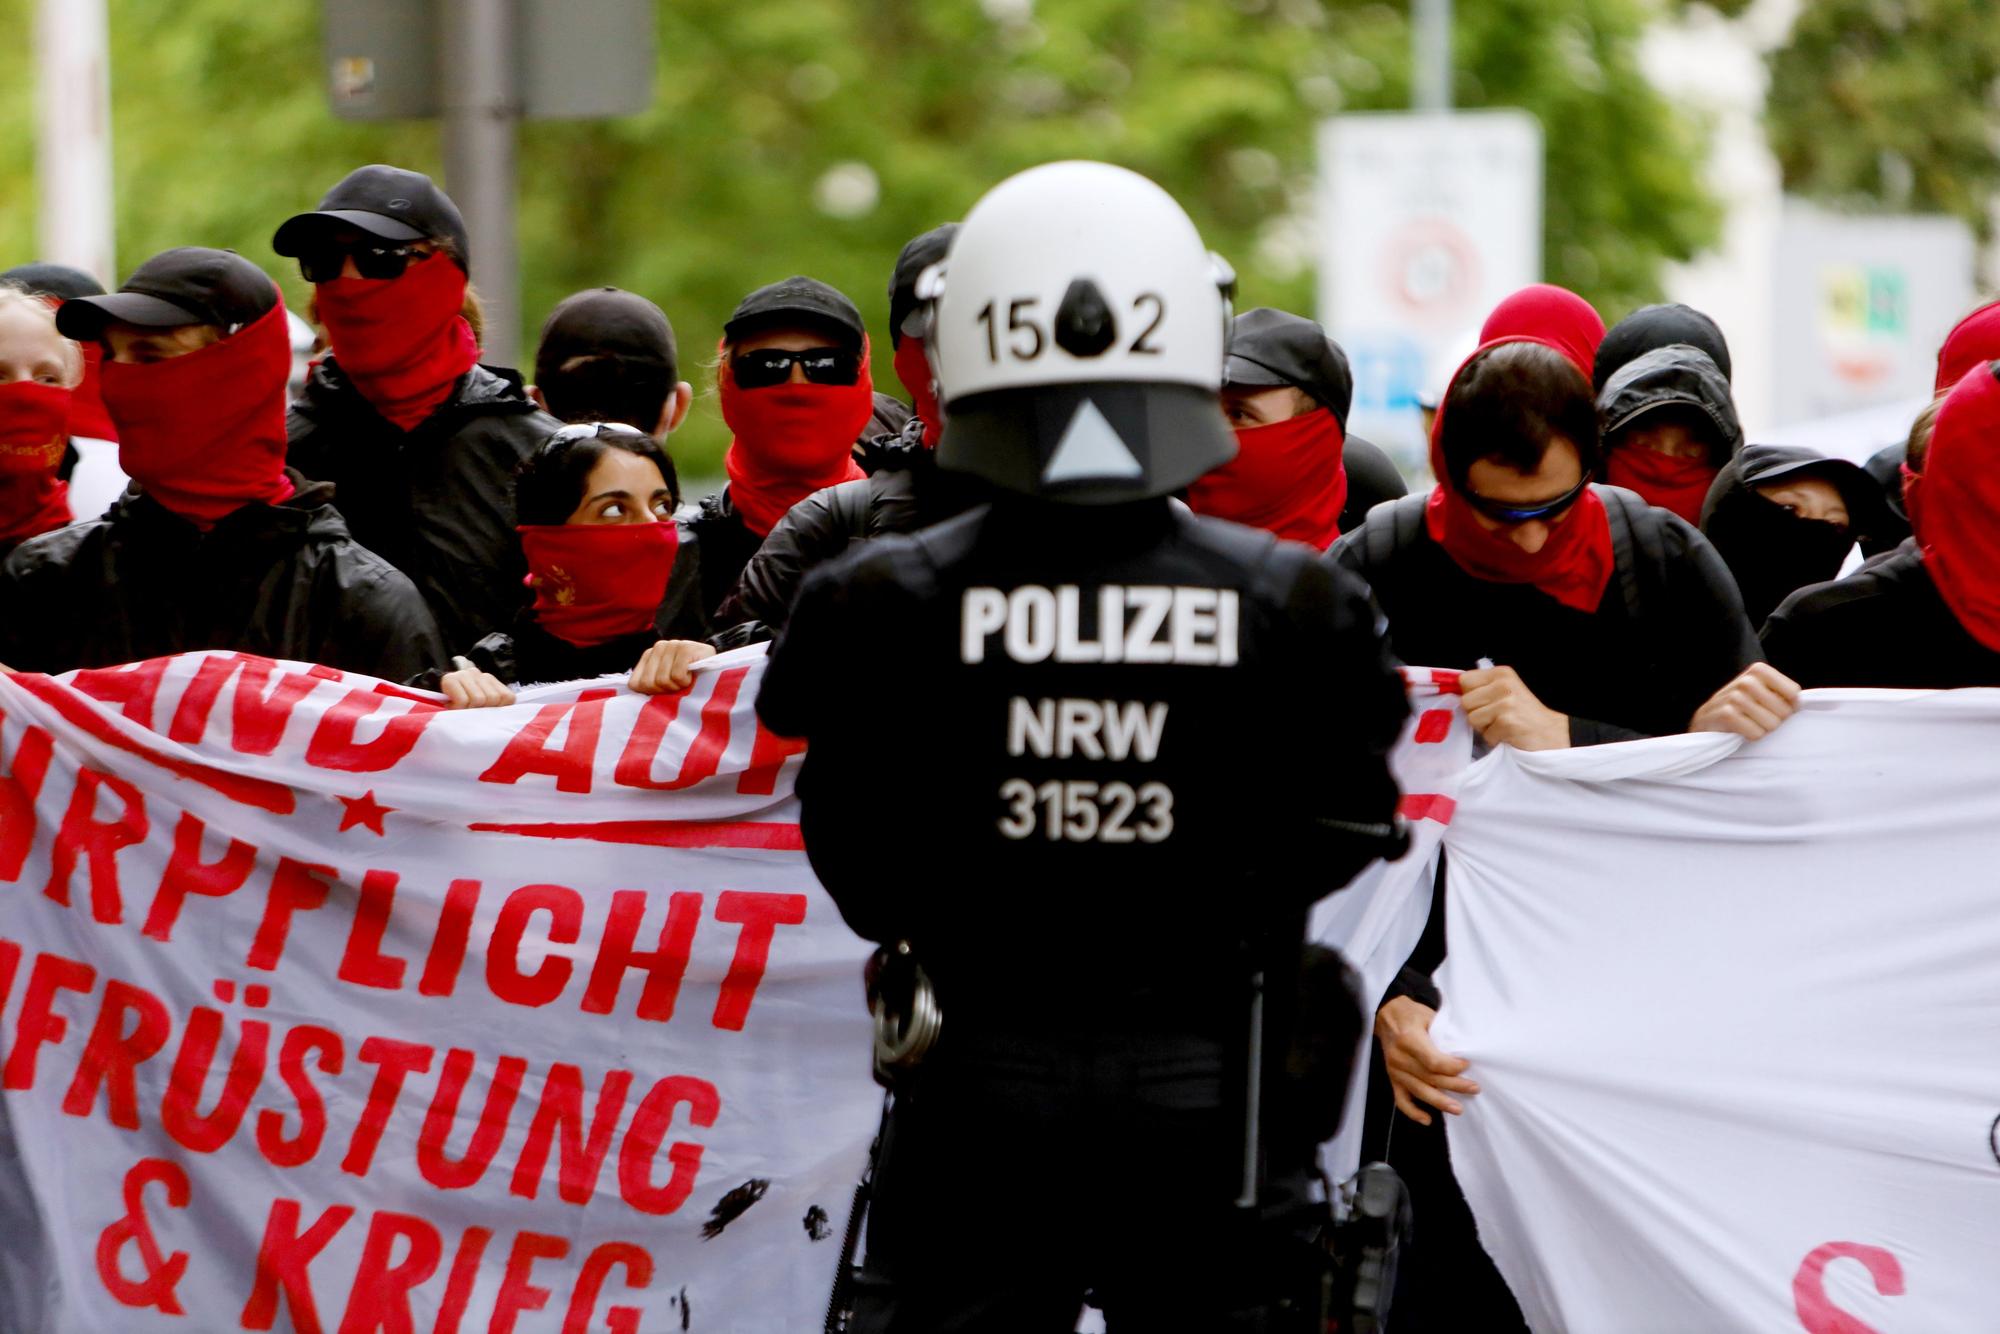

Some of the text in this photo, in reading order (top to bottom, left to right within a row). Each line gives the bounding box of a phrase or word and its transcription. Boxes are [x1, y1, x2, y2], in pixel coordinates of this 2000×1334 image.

[976, 293, 1168, 362] 15 2
[960, 584, 1240, 667] POLIZEI
[1007, 696, 1169, 762] NRW
[998, 779, 1175, 843] 31523
[95, 1157, 192, 1317] &
